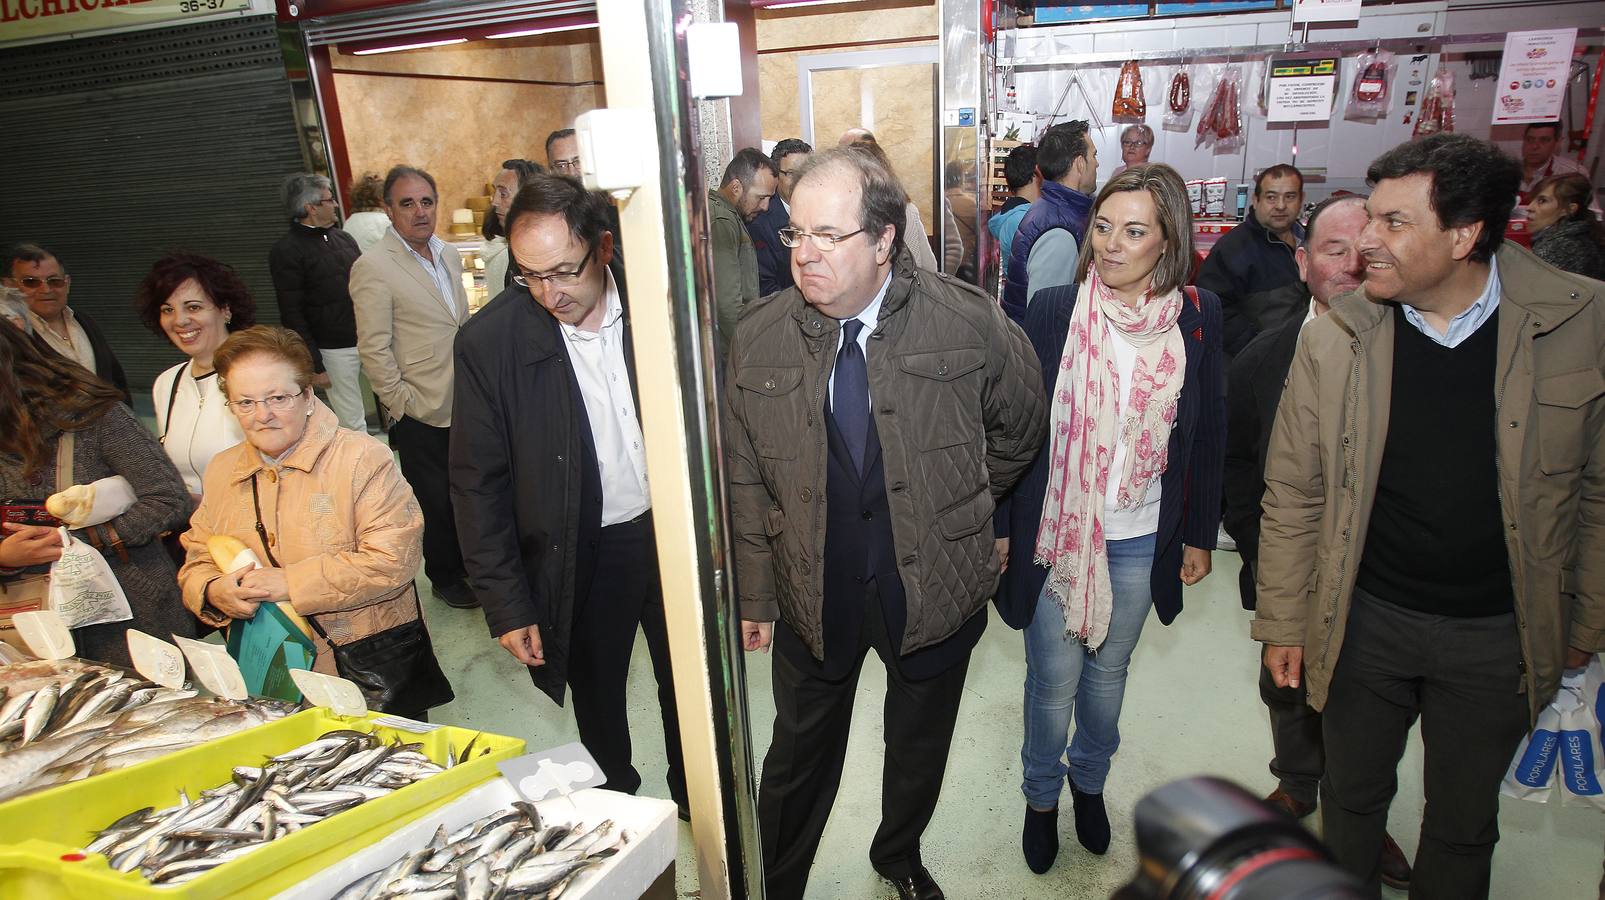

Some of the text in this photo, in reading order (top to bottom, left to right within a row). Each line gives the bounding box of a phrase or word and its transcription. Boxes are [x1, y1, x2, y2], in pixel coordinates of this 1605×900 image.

[180, 0, 224, 13] 36-37
[1527, 736, 1557, 784] POPULARES
[1568, 735, 1589, 791] POPULARES
